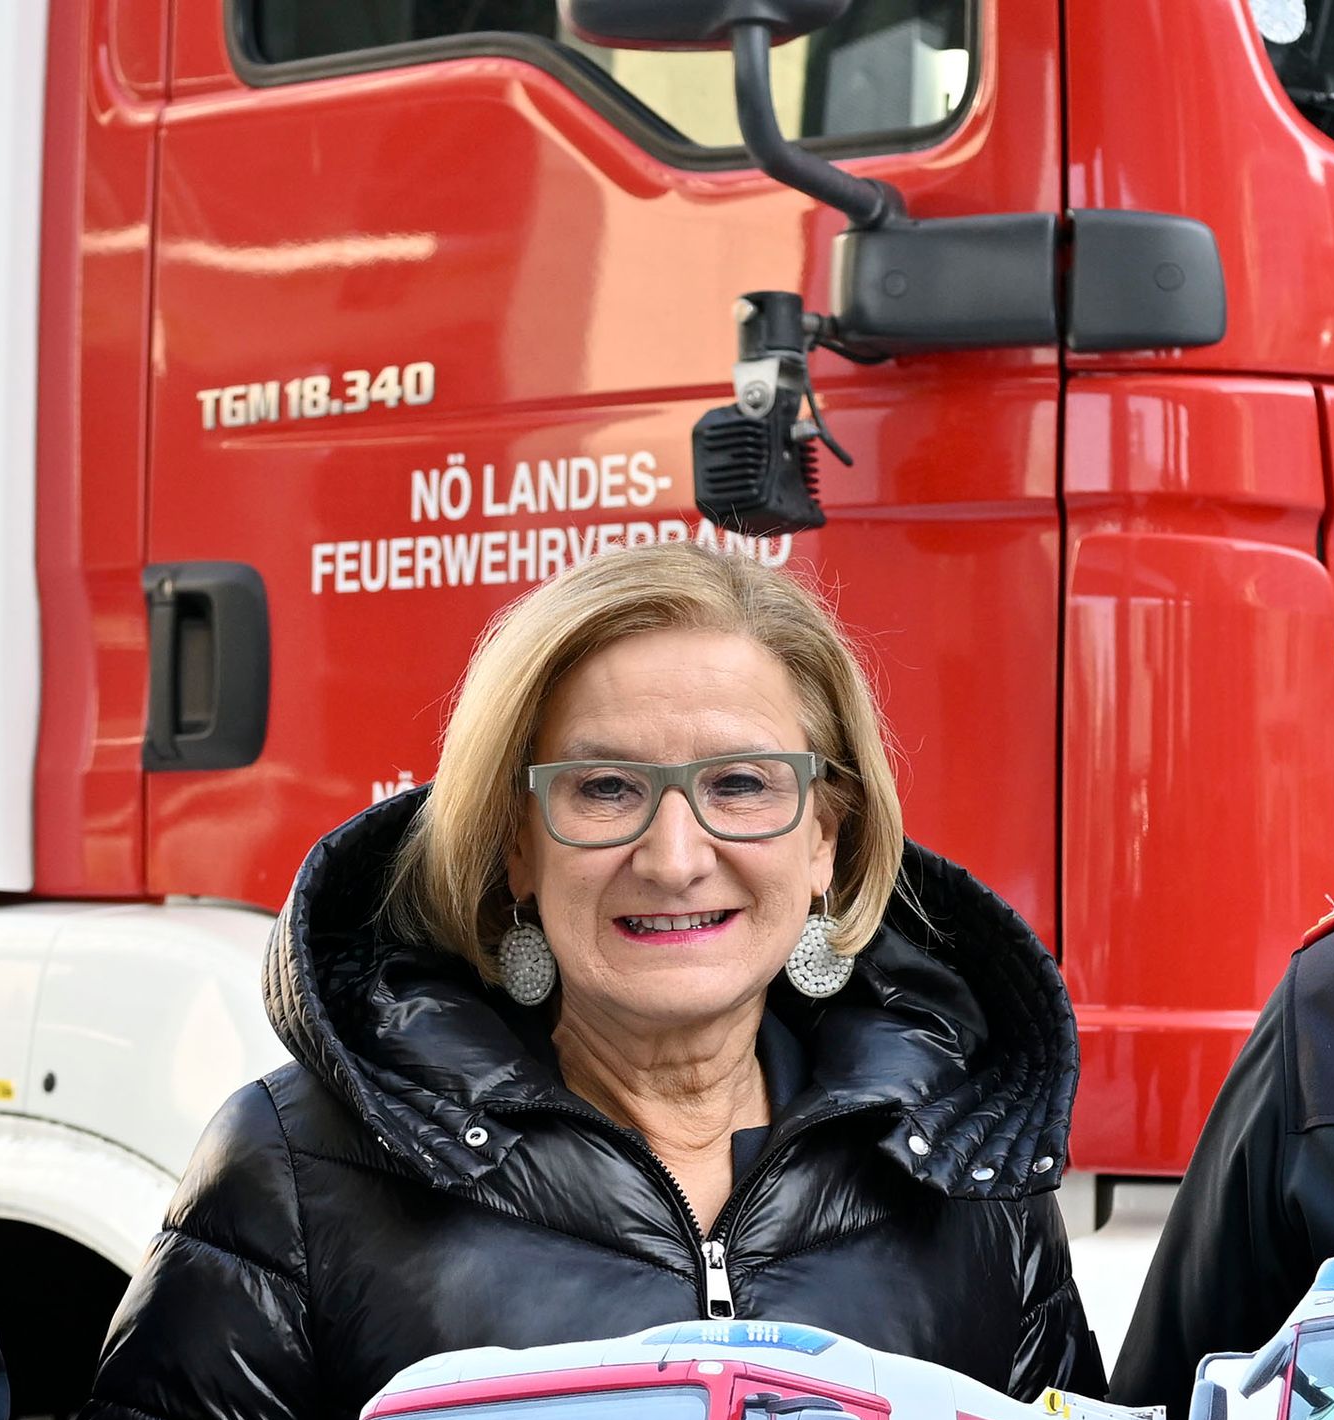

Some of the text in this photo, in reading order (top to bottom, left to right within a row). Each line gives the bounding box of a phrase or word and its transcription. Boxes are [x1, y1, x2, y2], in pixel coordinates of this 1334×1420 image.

[196, 361, 435, 430] TGM 18.340
[411, 451, 673, 522] NÖ LANDES-
